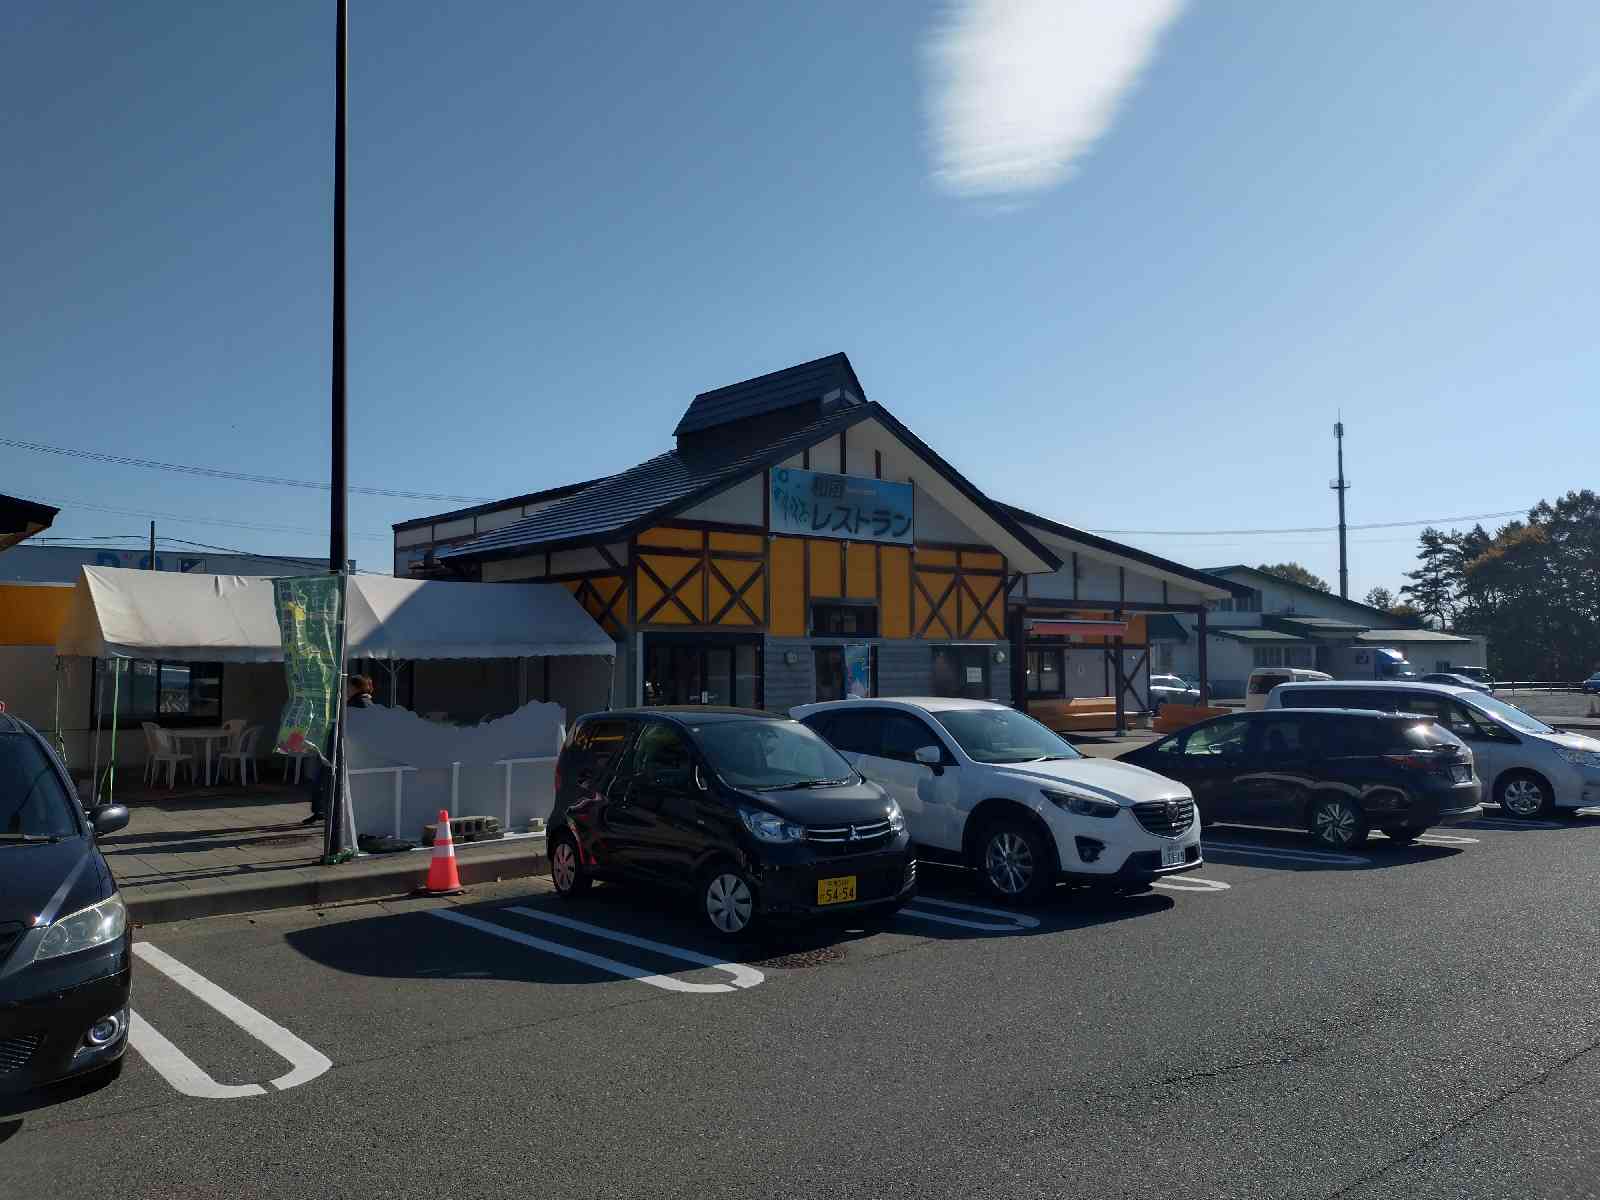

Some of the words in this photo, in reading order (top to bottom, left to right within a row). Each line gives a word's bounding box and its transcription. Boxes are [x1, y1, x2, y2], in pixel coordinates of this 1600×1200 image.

[812, 503, 912, 537] レストラン
